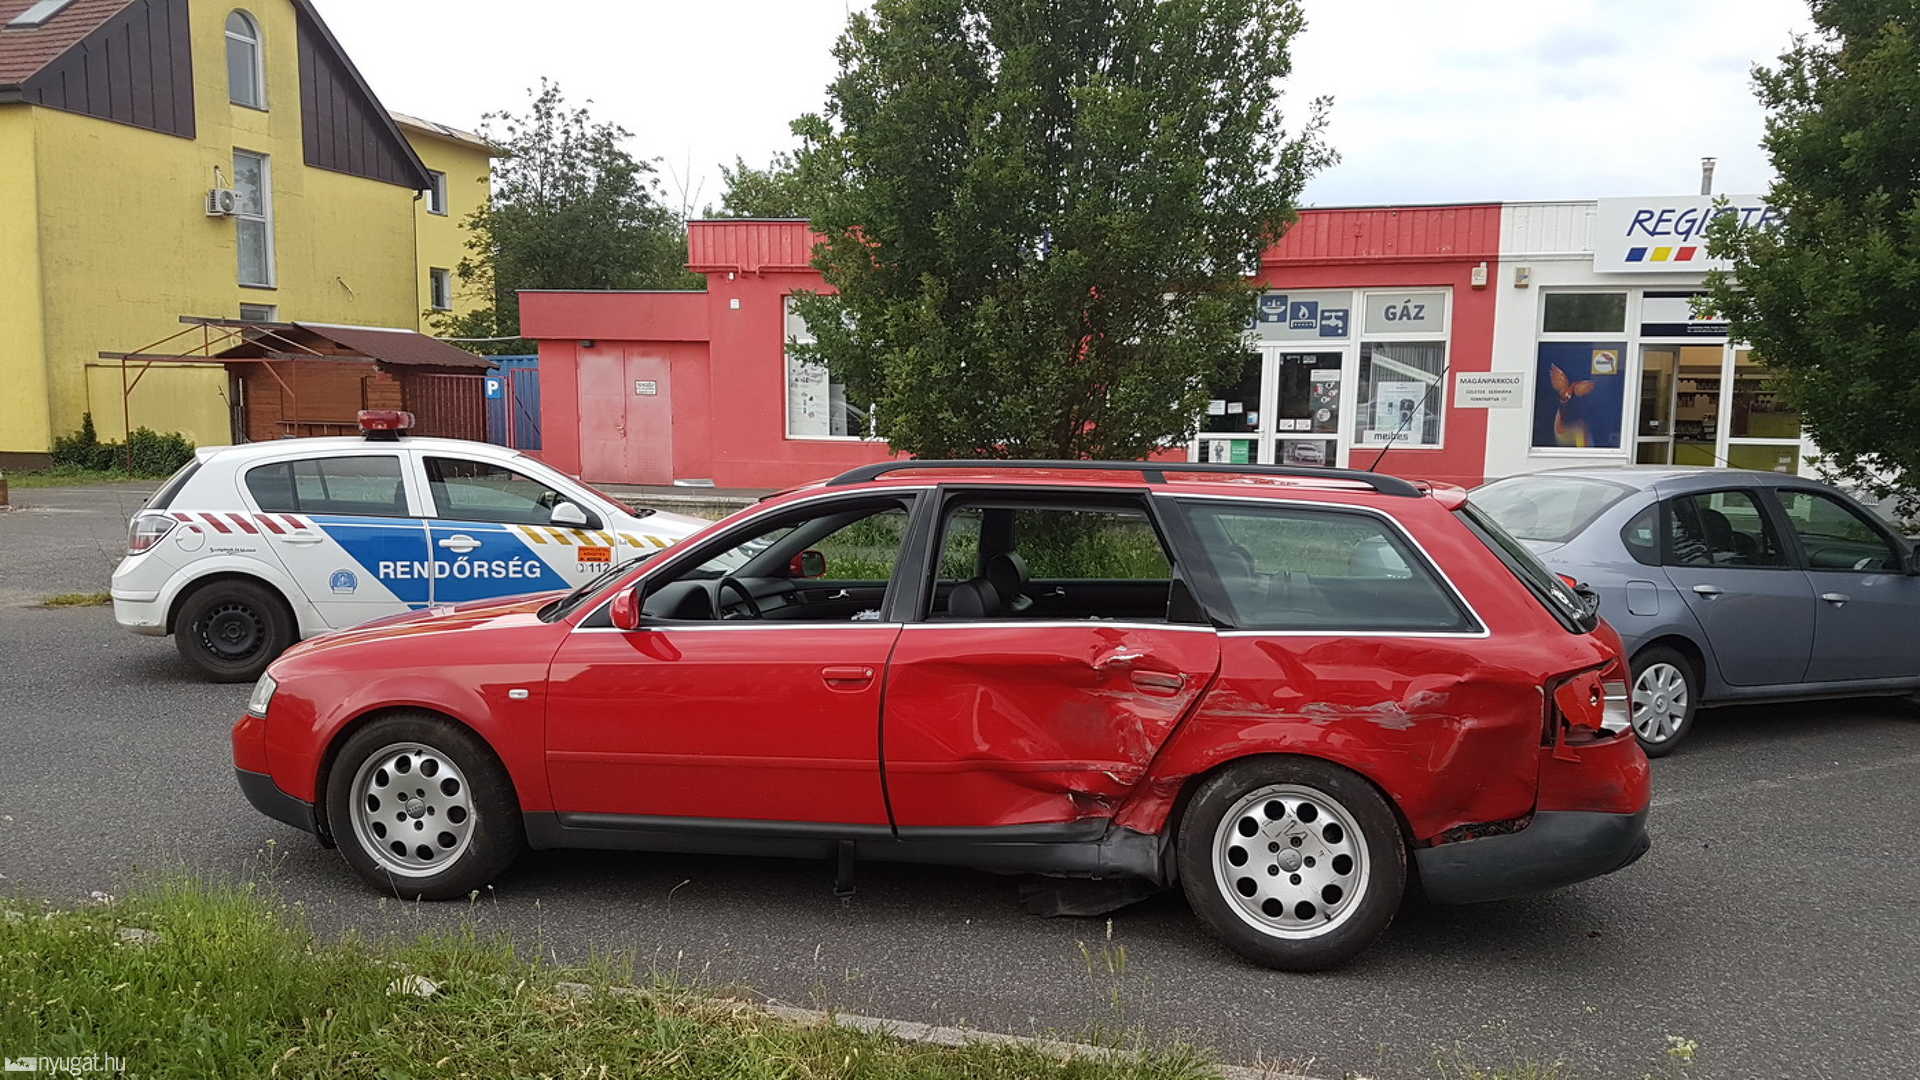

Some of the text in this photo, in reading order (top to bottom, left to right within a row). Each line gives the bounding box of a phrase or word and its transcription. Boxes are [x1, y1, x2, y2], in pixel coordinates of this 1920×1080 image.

[1384, 298, 1425, 321] GÁZ
[487, 380, 499, 395] P
[378, 556, 541, 579] RENDŐRSÉG
[589, 562, 611, 573] 112
